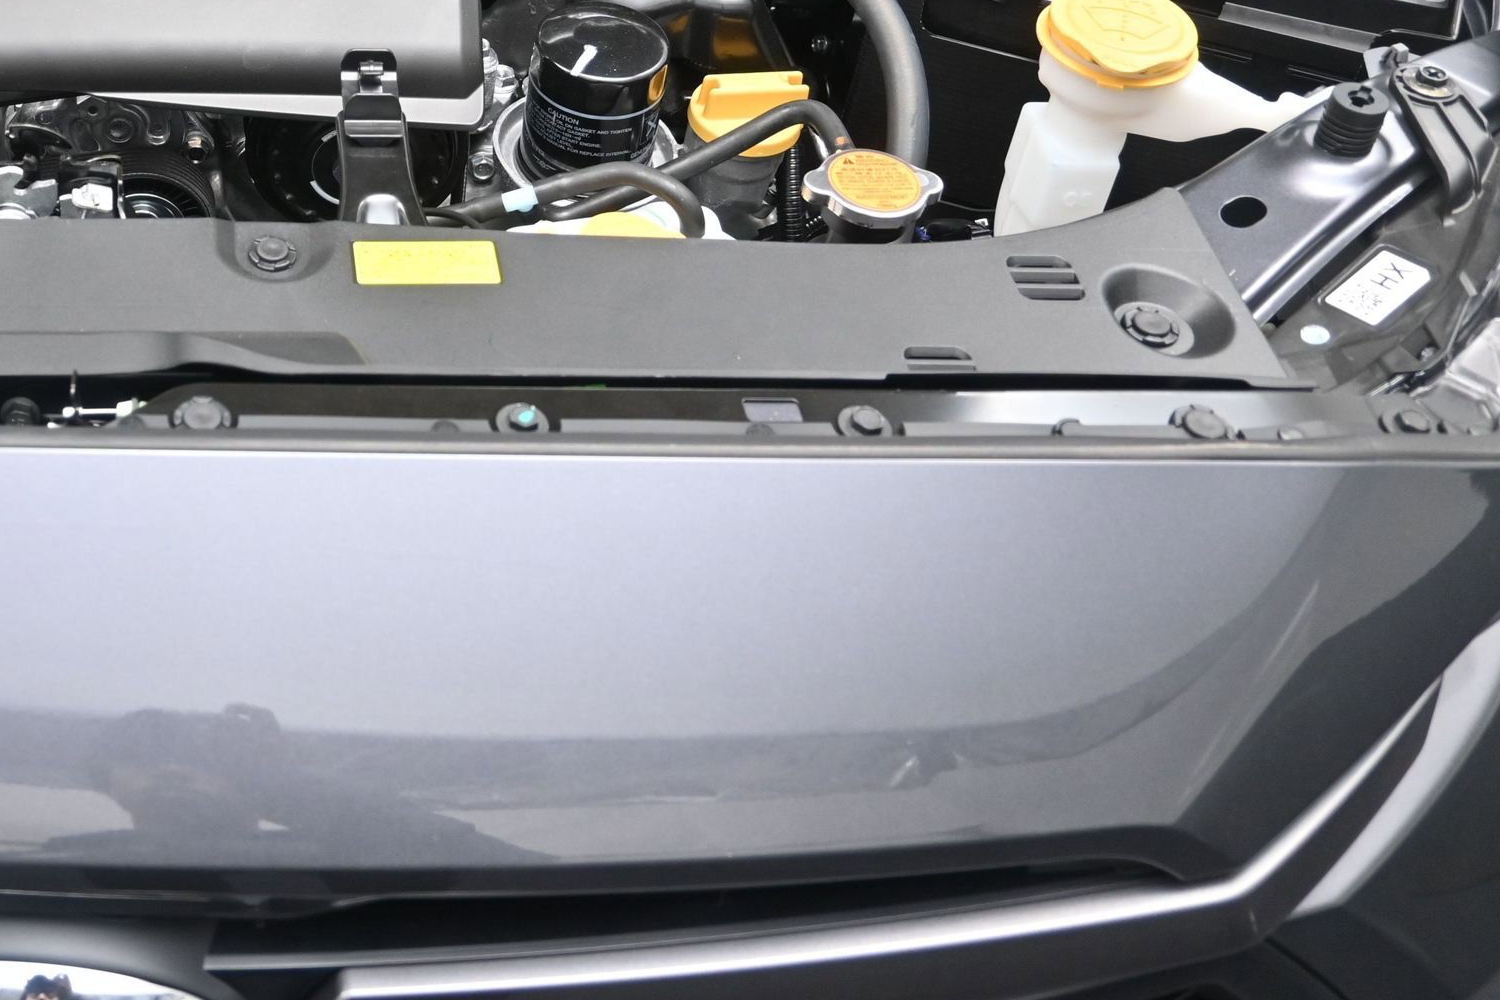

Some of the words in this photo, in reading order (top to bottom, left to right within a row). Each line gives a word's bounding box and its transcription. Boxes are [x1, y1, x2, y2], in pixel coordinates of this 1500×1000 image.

[547, 107, 580, 126] CAUTION
[574, 126, 597, 135] GASKET
[610, 127, 633, 135] TIGHTEN
[1370, 262, 1413, 290] HX
